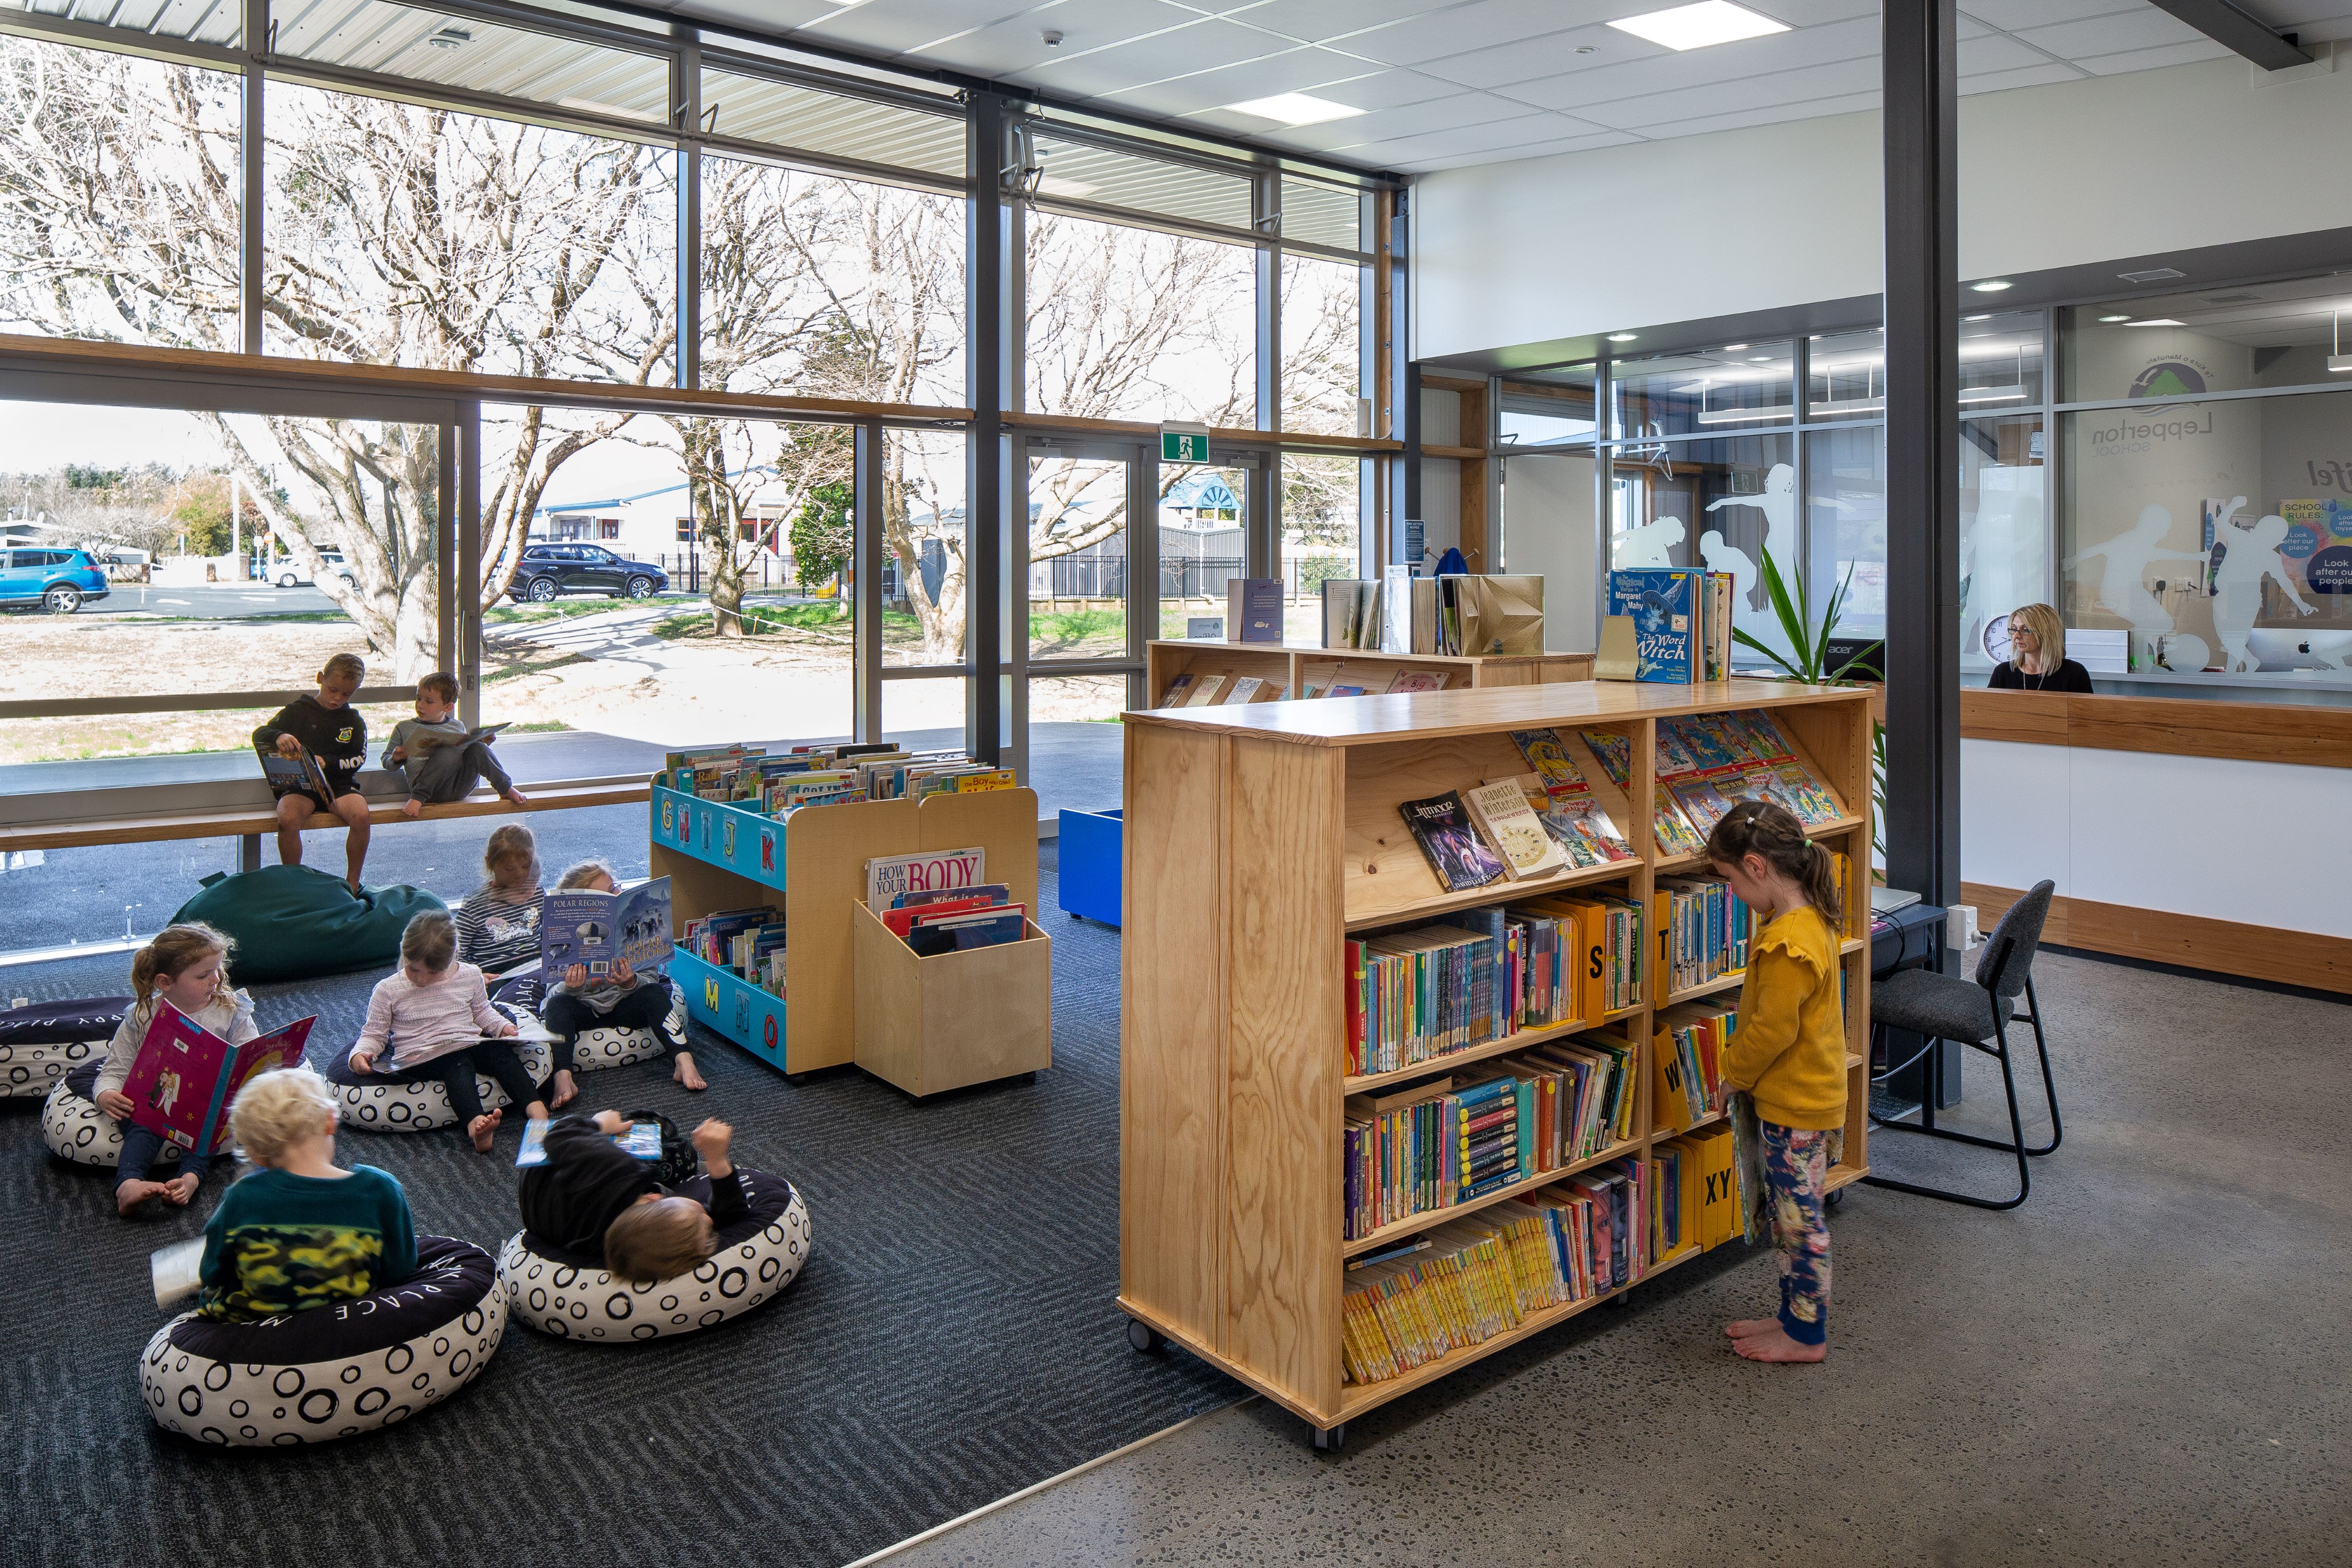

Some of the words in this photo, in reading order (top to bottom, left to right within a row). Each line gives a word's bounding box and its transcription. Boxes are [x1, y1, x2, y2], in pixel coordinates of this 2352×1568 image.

[1616, 577, 1645, 588] Magical
[1615, 592, 1641, 601] Margaret
[1628, 601, 1643, 610] Mahy
[1655, 634, 1686, 647] Word
[1828, 645, 1853, 654] acer
[1410, 679, 1426, 690] Big
[973, 777, 988, 786] Boy
[1479, 784, 1516, 803] Jeanette
[662, 800, 672, 829] G
[1481, 796, 1526, 816] Winterson
[1490, 808, 1531, 823] TANGLEWRECK
[679, 811, 689, 843] H
[702, 817, 709, 849] I
[724, 822, 735, 857] J
[762, 835, 774, 872] K
[878, 864, 906, 881] HOW
[907, 857, 978, 891] BODY
[1455, 880, 1472, 889] DAVID
[1482, 867, 1503, 882] STONE
[876, 879, 907, 895] YOUR
[625, 936, 662, 955] POLAR
[626, 943, 670, 965] EGIONS
[1658, 928, 1669, 961] T
[1589, 945, 1603, 979] S
[515, 978, 538, 1009] PLACE
[706, 976, 719, 1013] M
[764, 1014, 778, 1048] O
[1664, 1058, 1680, 1094] W
[336, 1284, 442, 1320] PLACE
